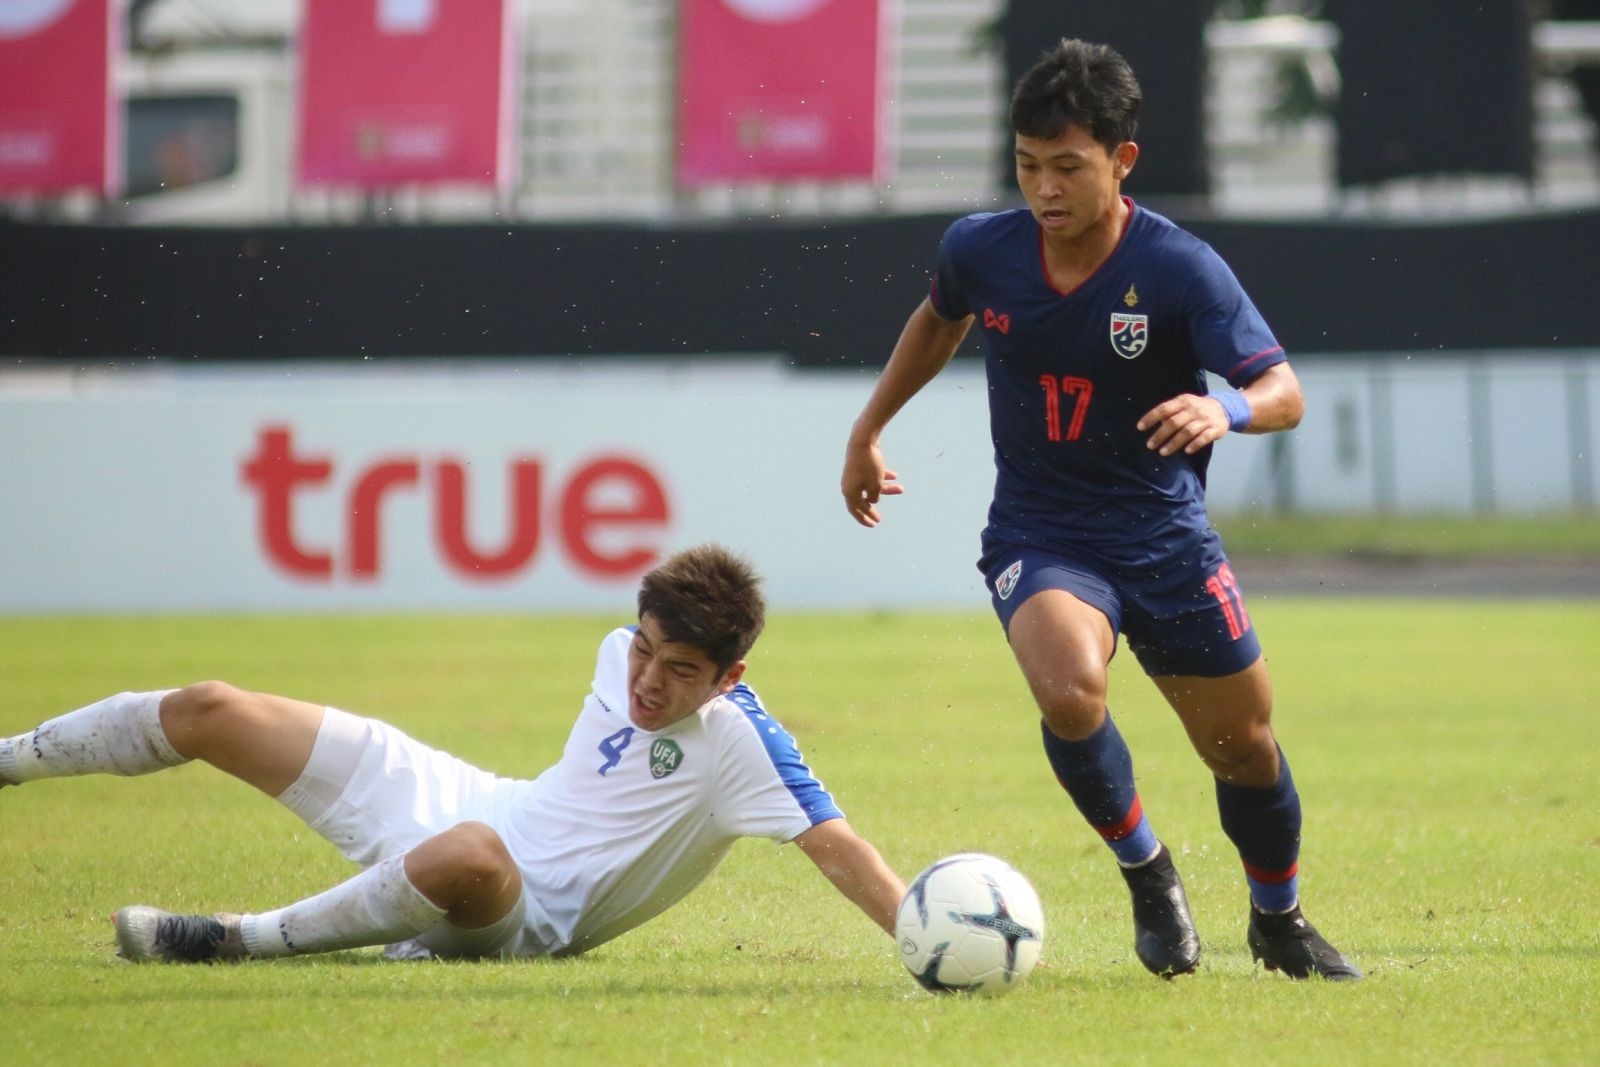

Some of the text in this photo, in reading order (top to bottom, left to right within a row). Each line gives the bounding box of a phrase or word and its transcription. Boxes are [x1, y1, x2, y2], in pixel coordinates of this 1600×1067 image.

[1040, 375, 1094, 441] 17
[242, 427, 670, 580] true
[598, 727, 635, 777] 4
[653, 742, 677, 767] UFA
